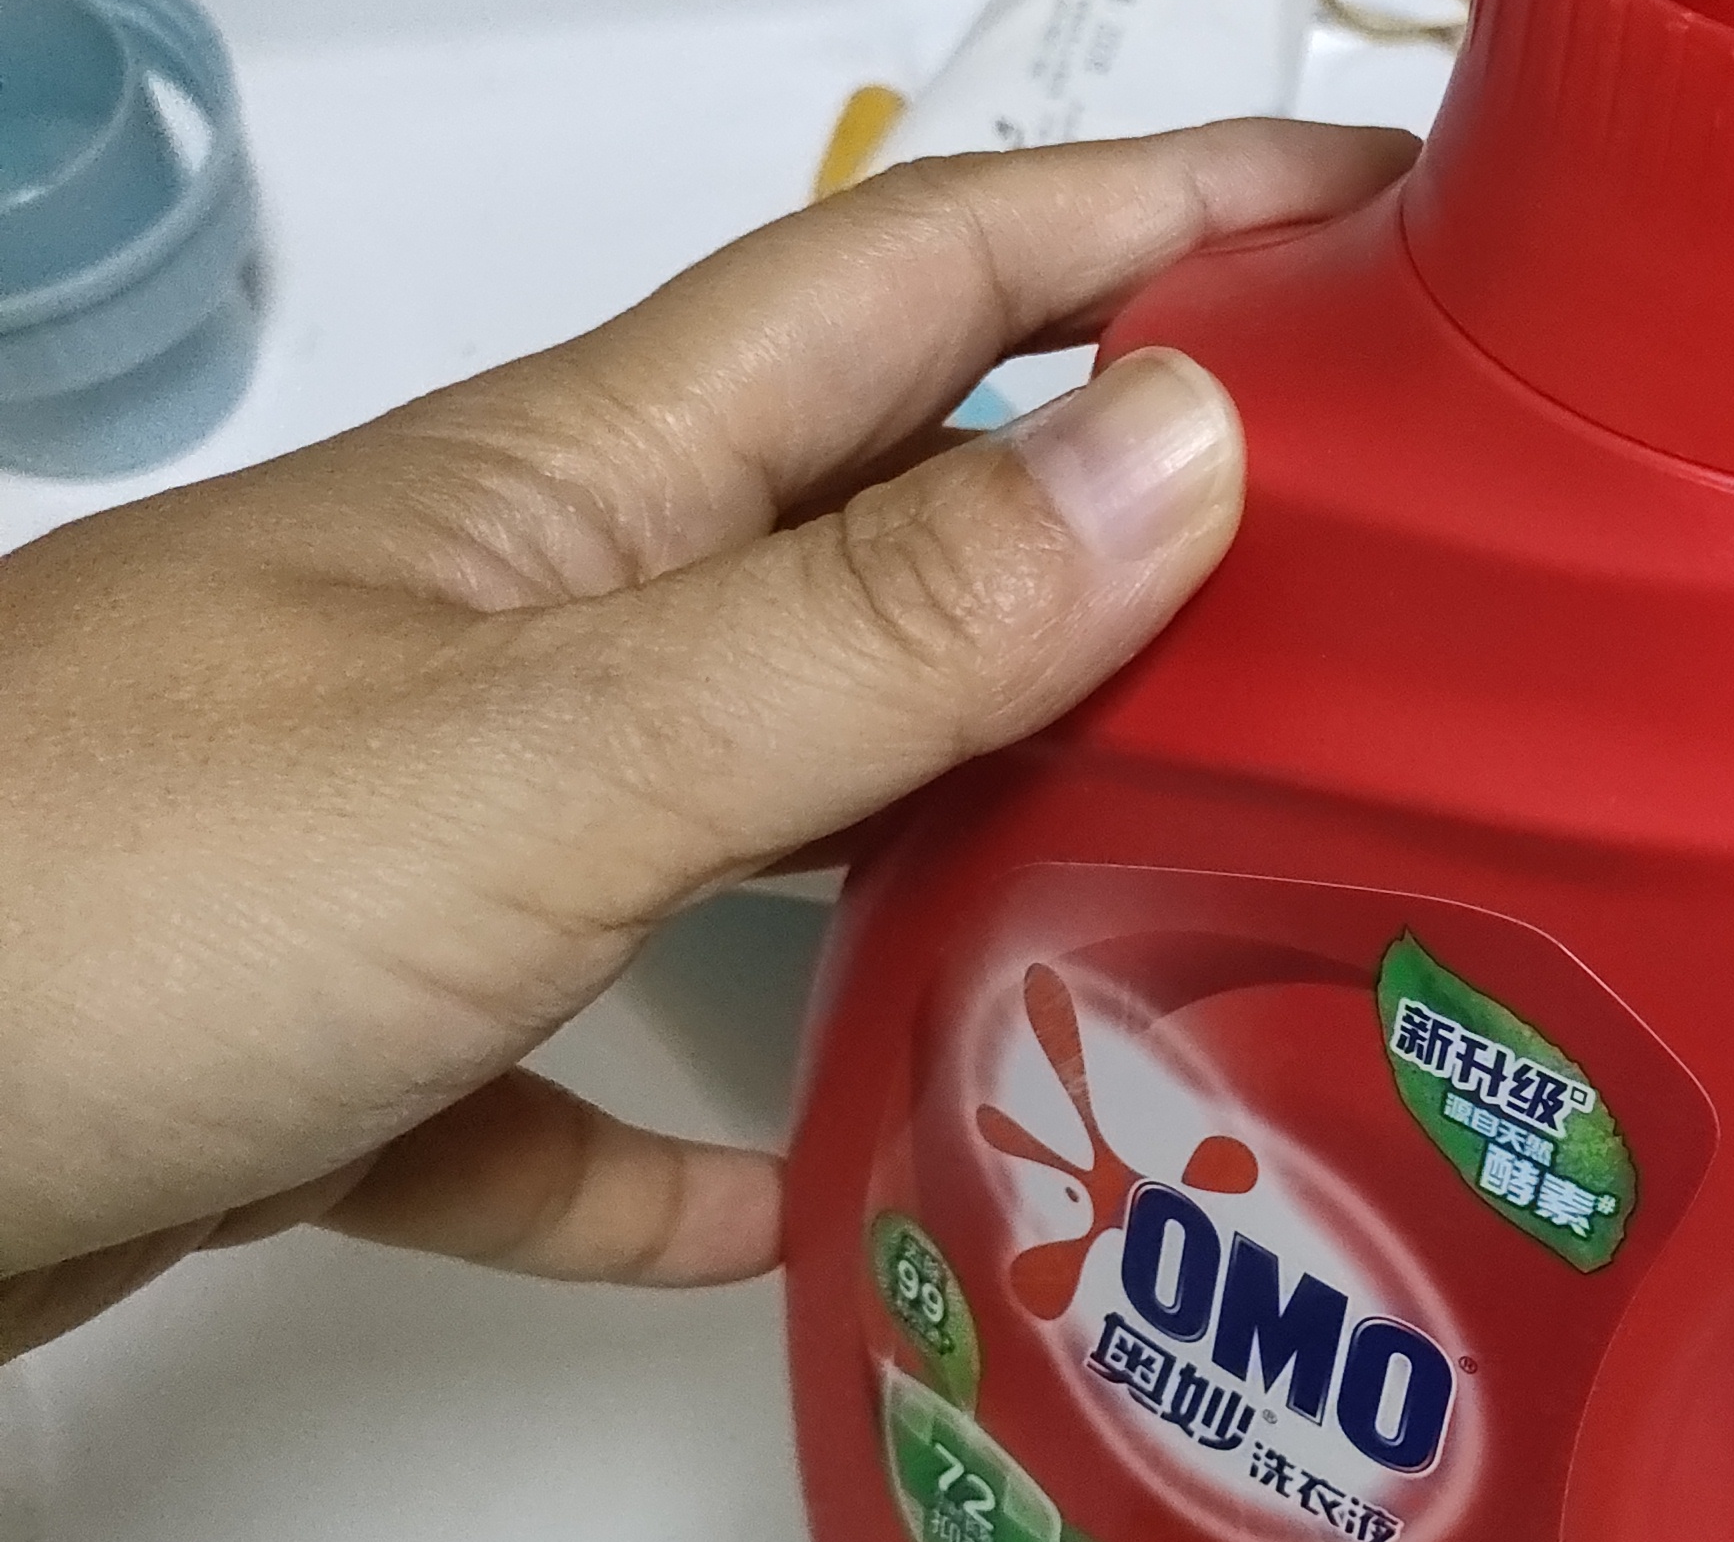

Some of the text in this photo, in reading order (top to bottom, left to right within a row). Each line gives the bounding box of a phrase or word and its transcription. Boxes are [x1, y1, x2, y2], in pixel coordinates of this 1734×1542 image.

[1442, 1091, 1555, 1168] 源自天然
[1089, 1312, 1256, 1452] 奥妙
[1121, 1181, 1457, 1477] OMO
